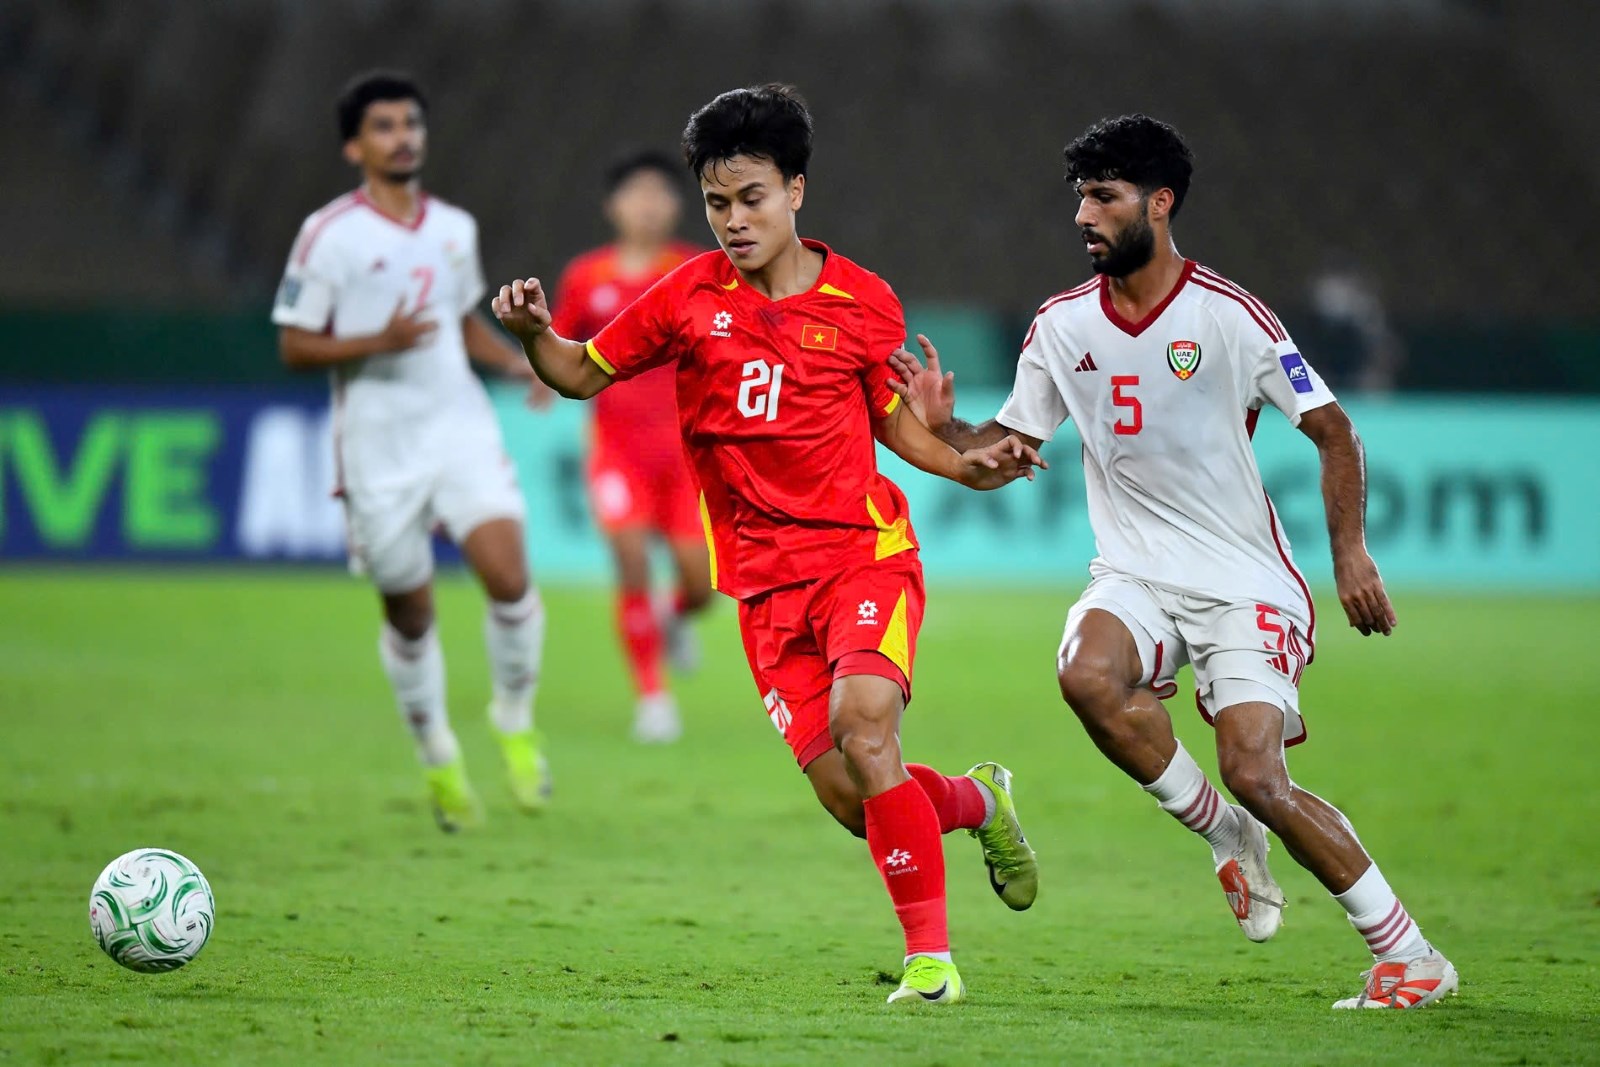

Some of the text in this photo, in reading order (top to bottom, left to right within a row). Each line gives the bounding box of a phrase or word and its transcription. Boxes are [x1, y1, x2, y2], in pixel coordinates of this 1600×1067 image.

[737, 359, 784, 422] 21
[1290, 365, 1306, 379] AFC
[1110, 375, 1143, 435] 5
[0, 408, 219, 548] VE
[1255, 603, 1286, 652] 5
